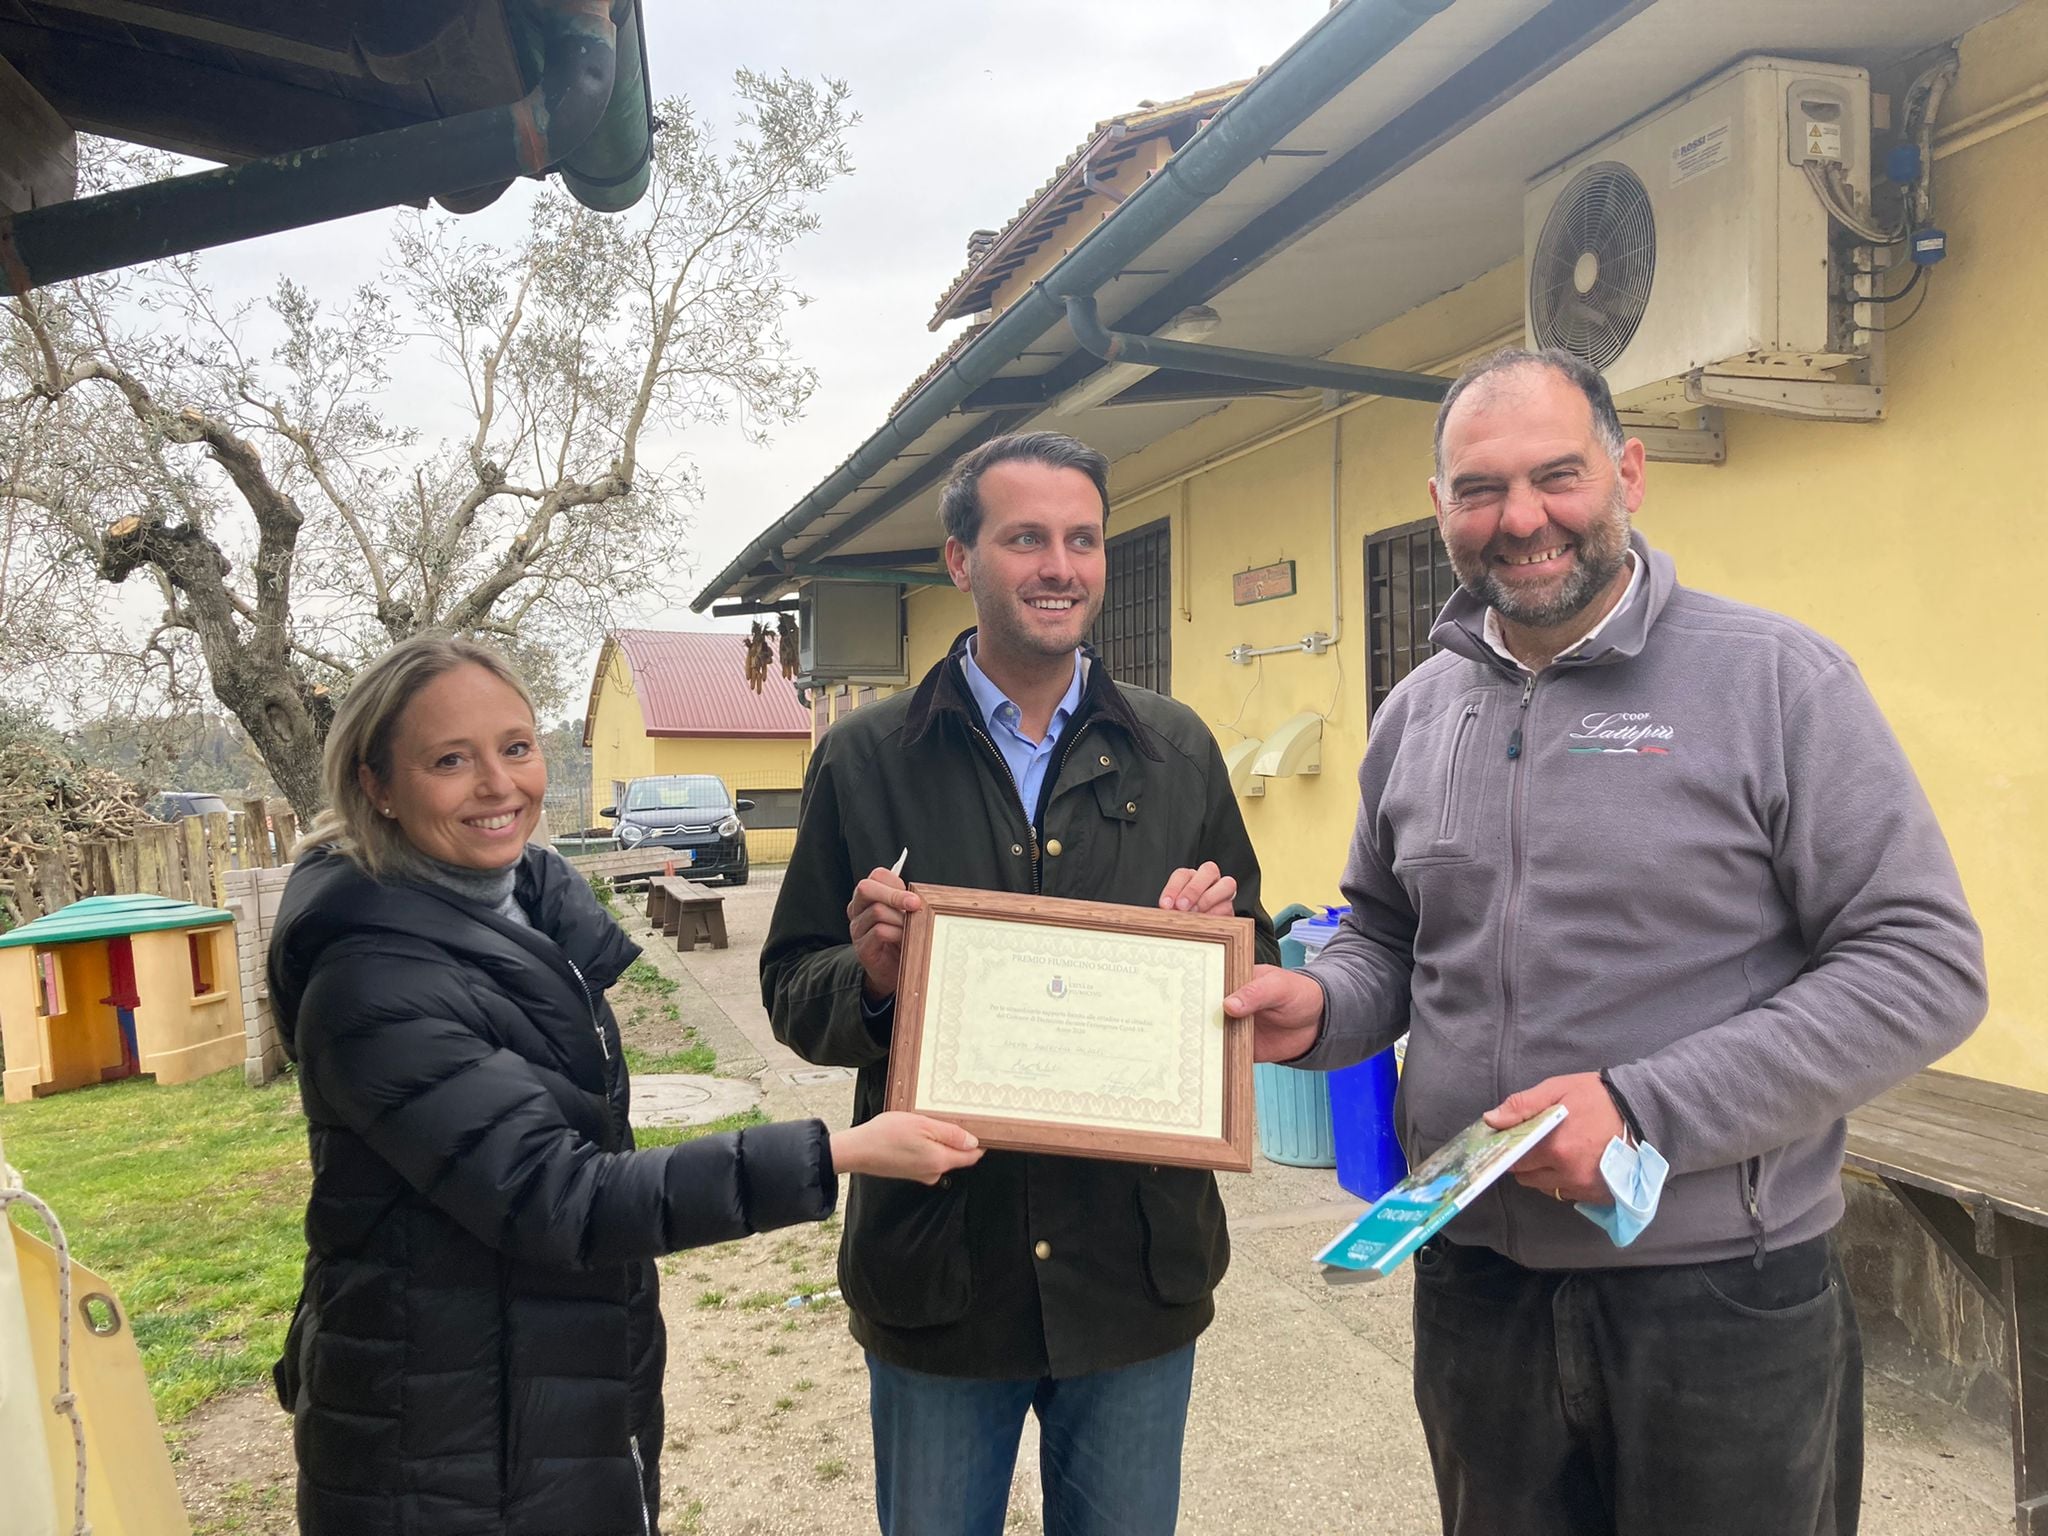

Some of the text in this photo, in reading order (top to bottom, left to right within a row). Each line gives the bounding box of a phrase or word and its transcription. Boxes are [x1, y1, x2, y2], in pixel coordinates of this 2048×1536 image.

[1680, 135, 1706, 155] ROSSI
[1011, 954, 1138, 975] PREMIO FIUMICINO SOLIDALE
